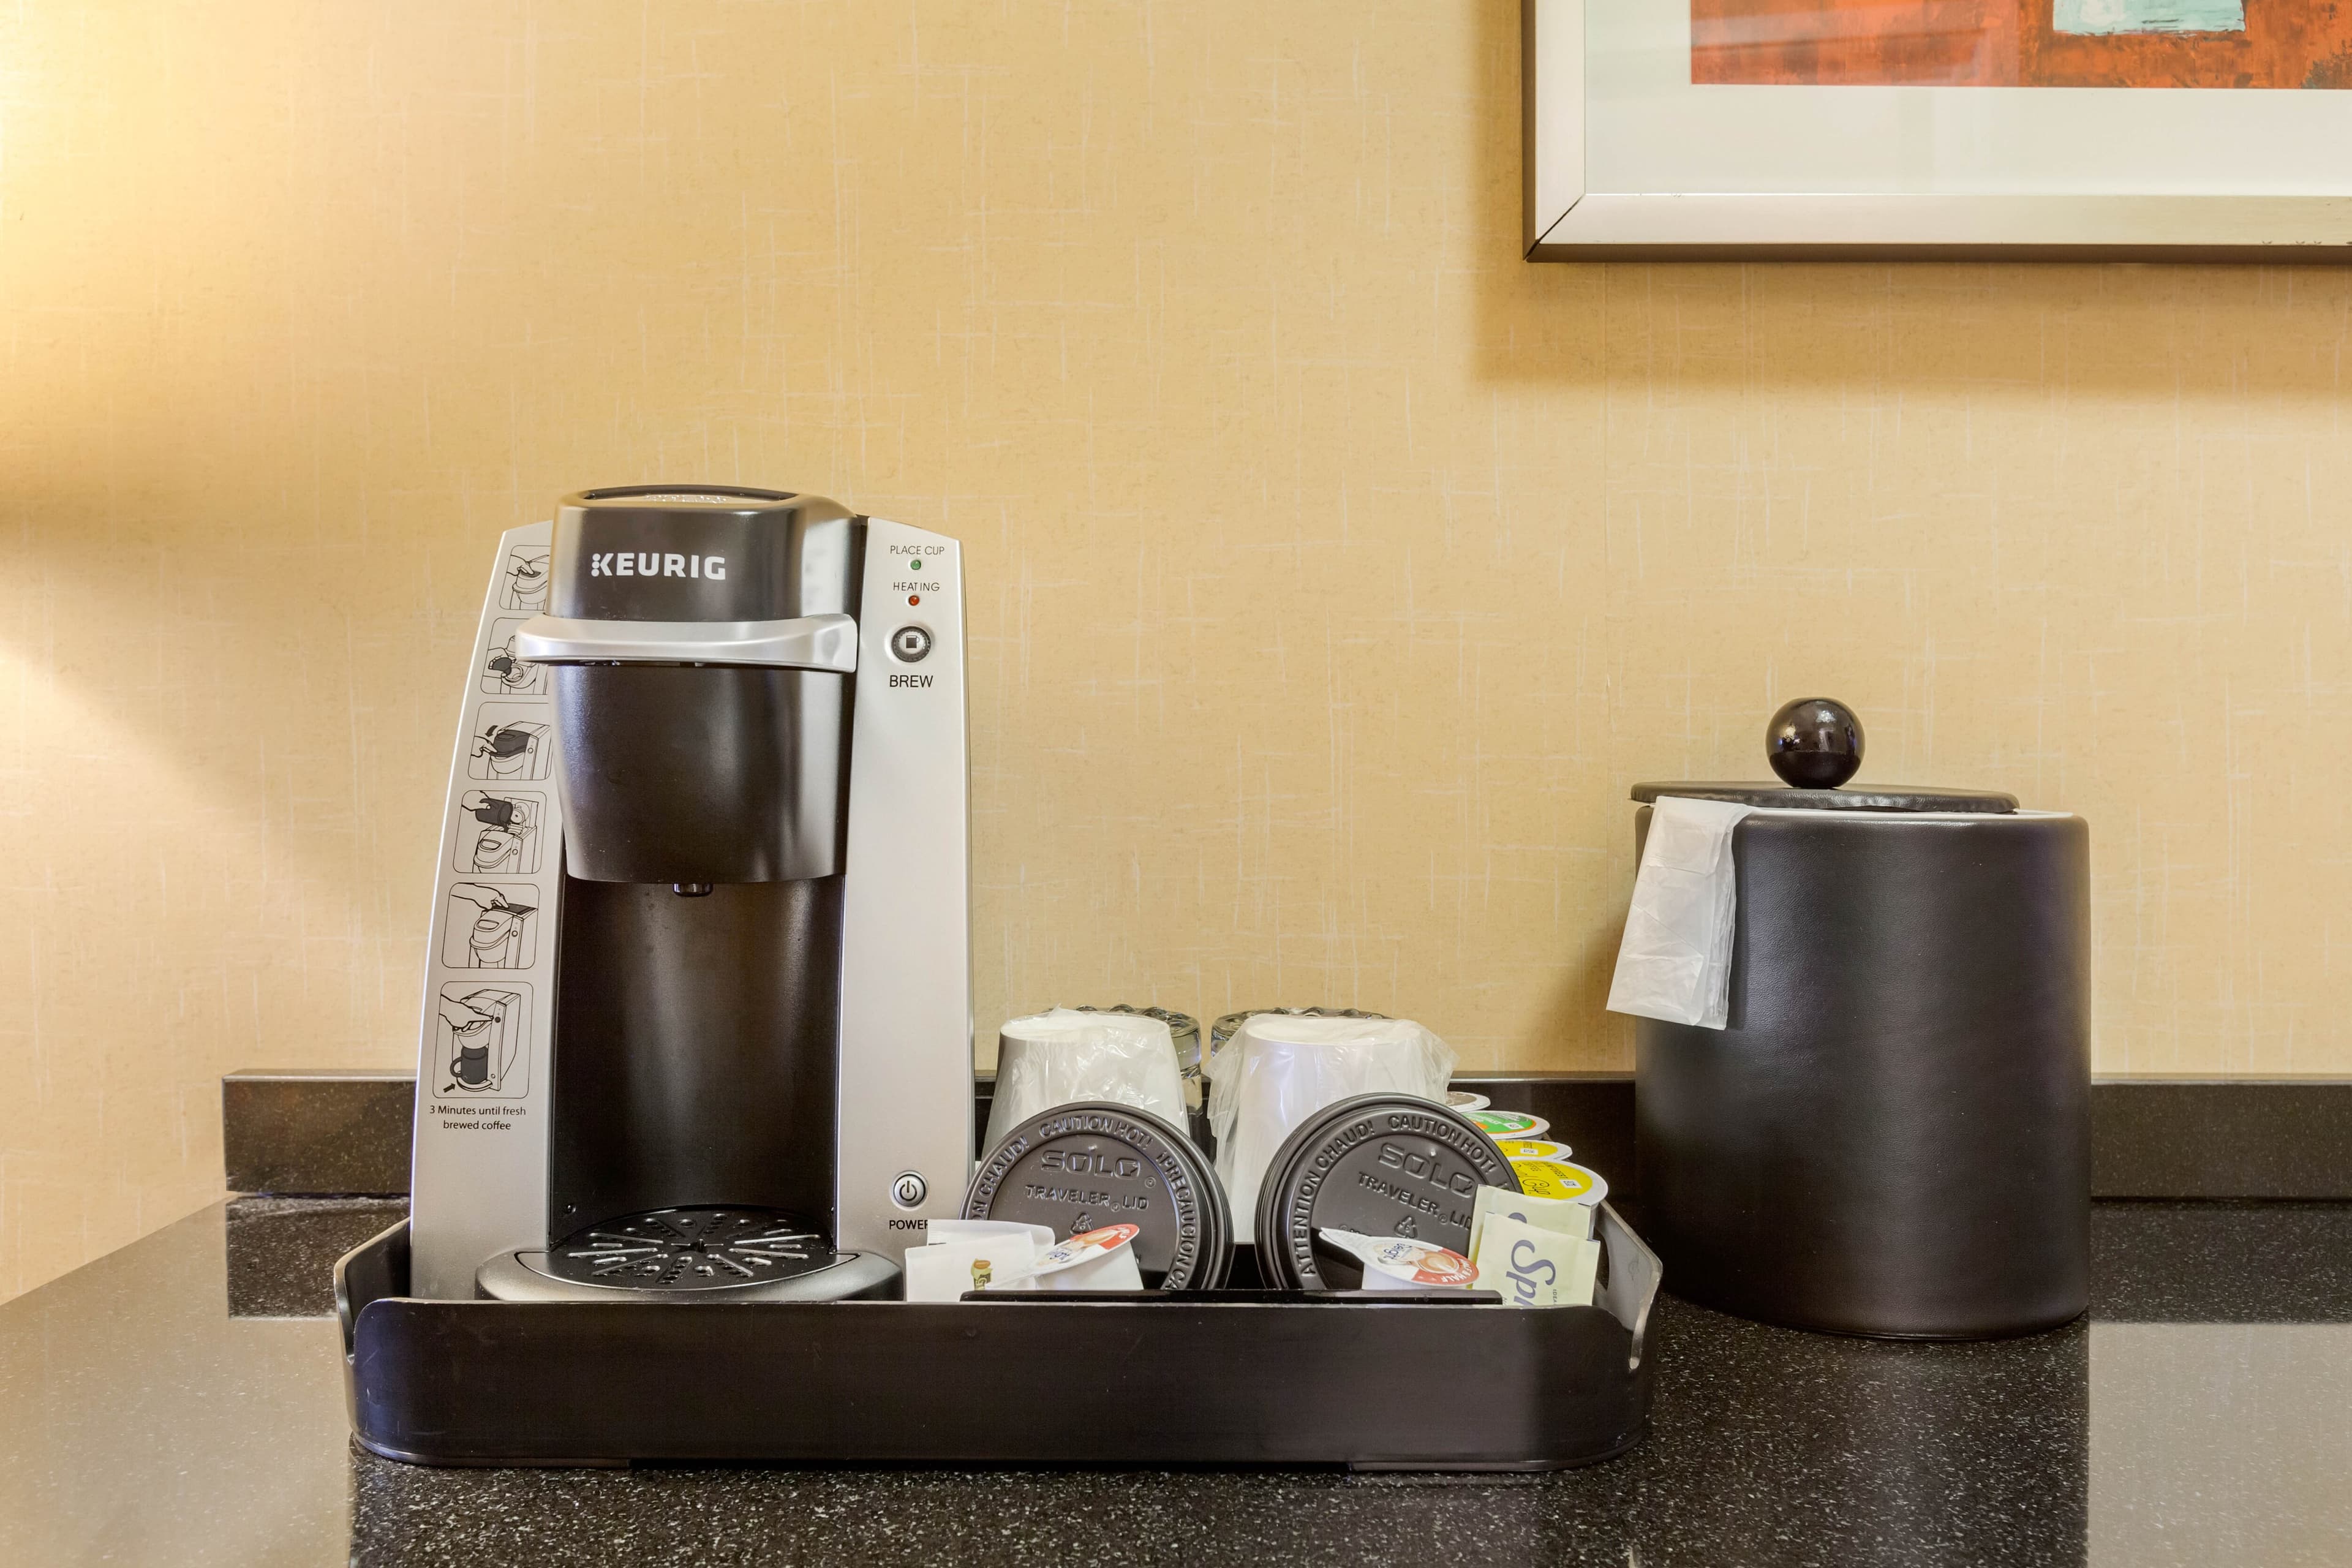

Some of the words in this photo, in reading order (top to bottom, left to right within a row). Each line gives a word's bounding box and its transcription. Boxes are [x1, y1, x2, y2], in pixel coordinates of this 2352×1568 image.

[890, 545, 921, 555] PLACE
[924, 546, 944, 555] CUP
[591, 552, 726, 580] KEURIG
[893, 582, 940, 592] HEATING
[889, 675, 933, 687] BREW
[429, 1105, 435, 1114] 3
[438, 1105, 476, 1115] Minutes
[479, 1106, 500, 1115] until
[503, 1106, 526, 1115] fresh
[443, 1120, 479, 1129] brewed
[481, 1121, 511, 1129] coffee
[979, 1136, 1030, 1197] CHAUD!
[1039, 1116, 1113, 1138] CAUTION
[1114, 1121, 1153, 1150] HOT!
[1041, 1150, 1140, 1179] SOLO
[1379, 1142, 1476, 1198] SOLO
[1025, 1185, 1110, 1207] TRAVELER
[1122, 1196, 1149, 1210] LID
[1294, 1170, 1321, 1276] ATTENTION
[1316, 1120, 1375, 1170] CHAUD!
[1389, 1115, 1460, 1146] CAUTION
[1461, 1137, 1496, 1174] HOT!
[1358, 1171, 1439, 1218] TRAVELER
